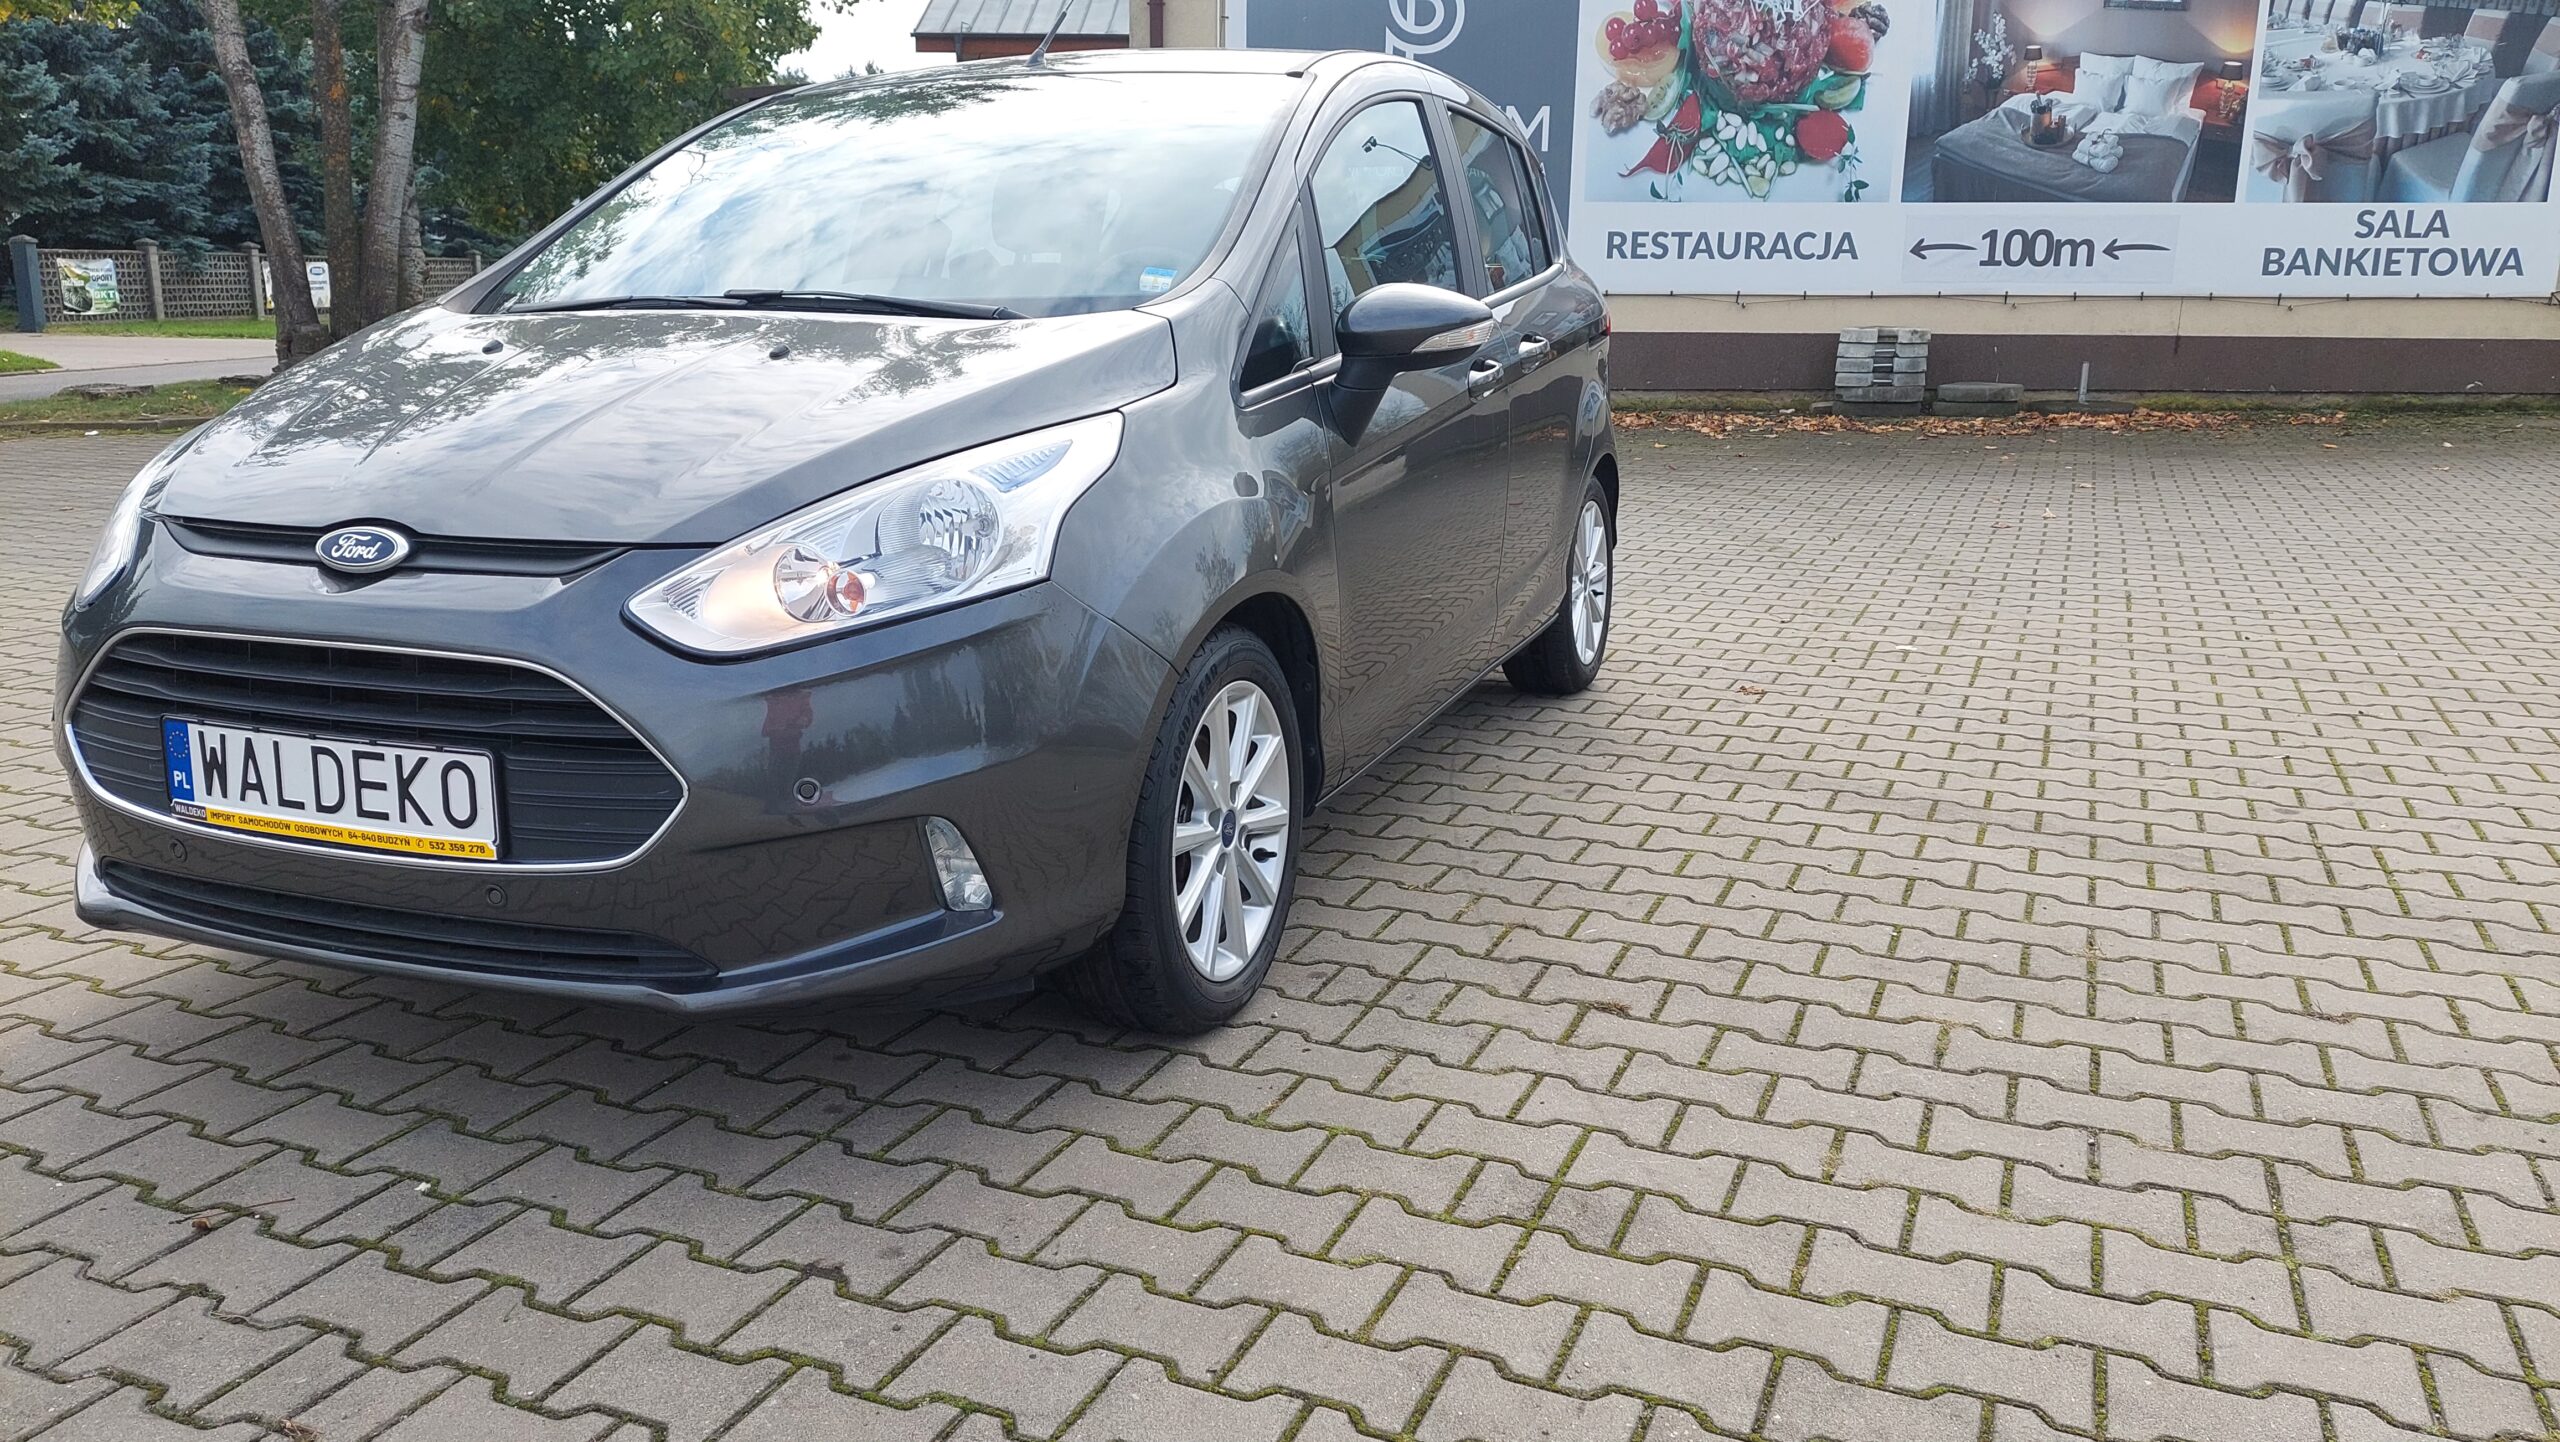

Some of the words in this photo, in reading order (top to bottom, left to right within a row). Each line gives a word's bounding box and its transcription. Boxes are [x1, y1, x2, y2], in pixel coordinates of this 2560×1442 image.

[2354, 209, 2450, 239] SALA
[1606, 231, 1859, 260] RESTAURACJA
[1979, 228, 2095, 267] 100m
[2261, 247, 2524, 276] BANKIETOWA
[331, 533, 382, 560] Ford
[173, 770, 191, 789] PL
[197, 729, 478, 830] WALDEKO
[174, 803, 206, 818] WALDEKO
[210, 811, 235, 823] IMPORT
[238, 816, 291, 831] SAMOCHODÓW
[294, 825, 344, 838] OSOBOWYCH
[347, 832, 376, 842] 64-840
[429, 841, 445, 850] 532
